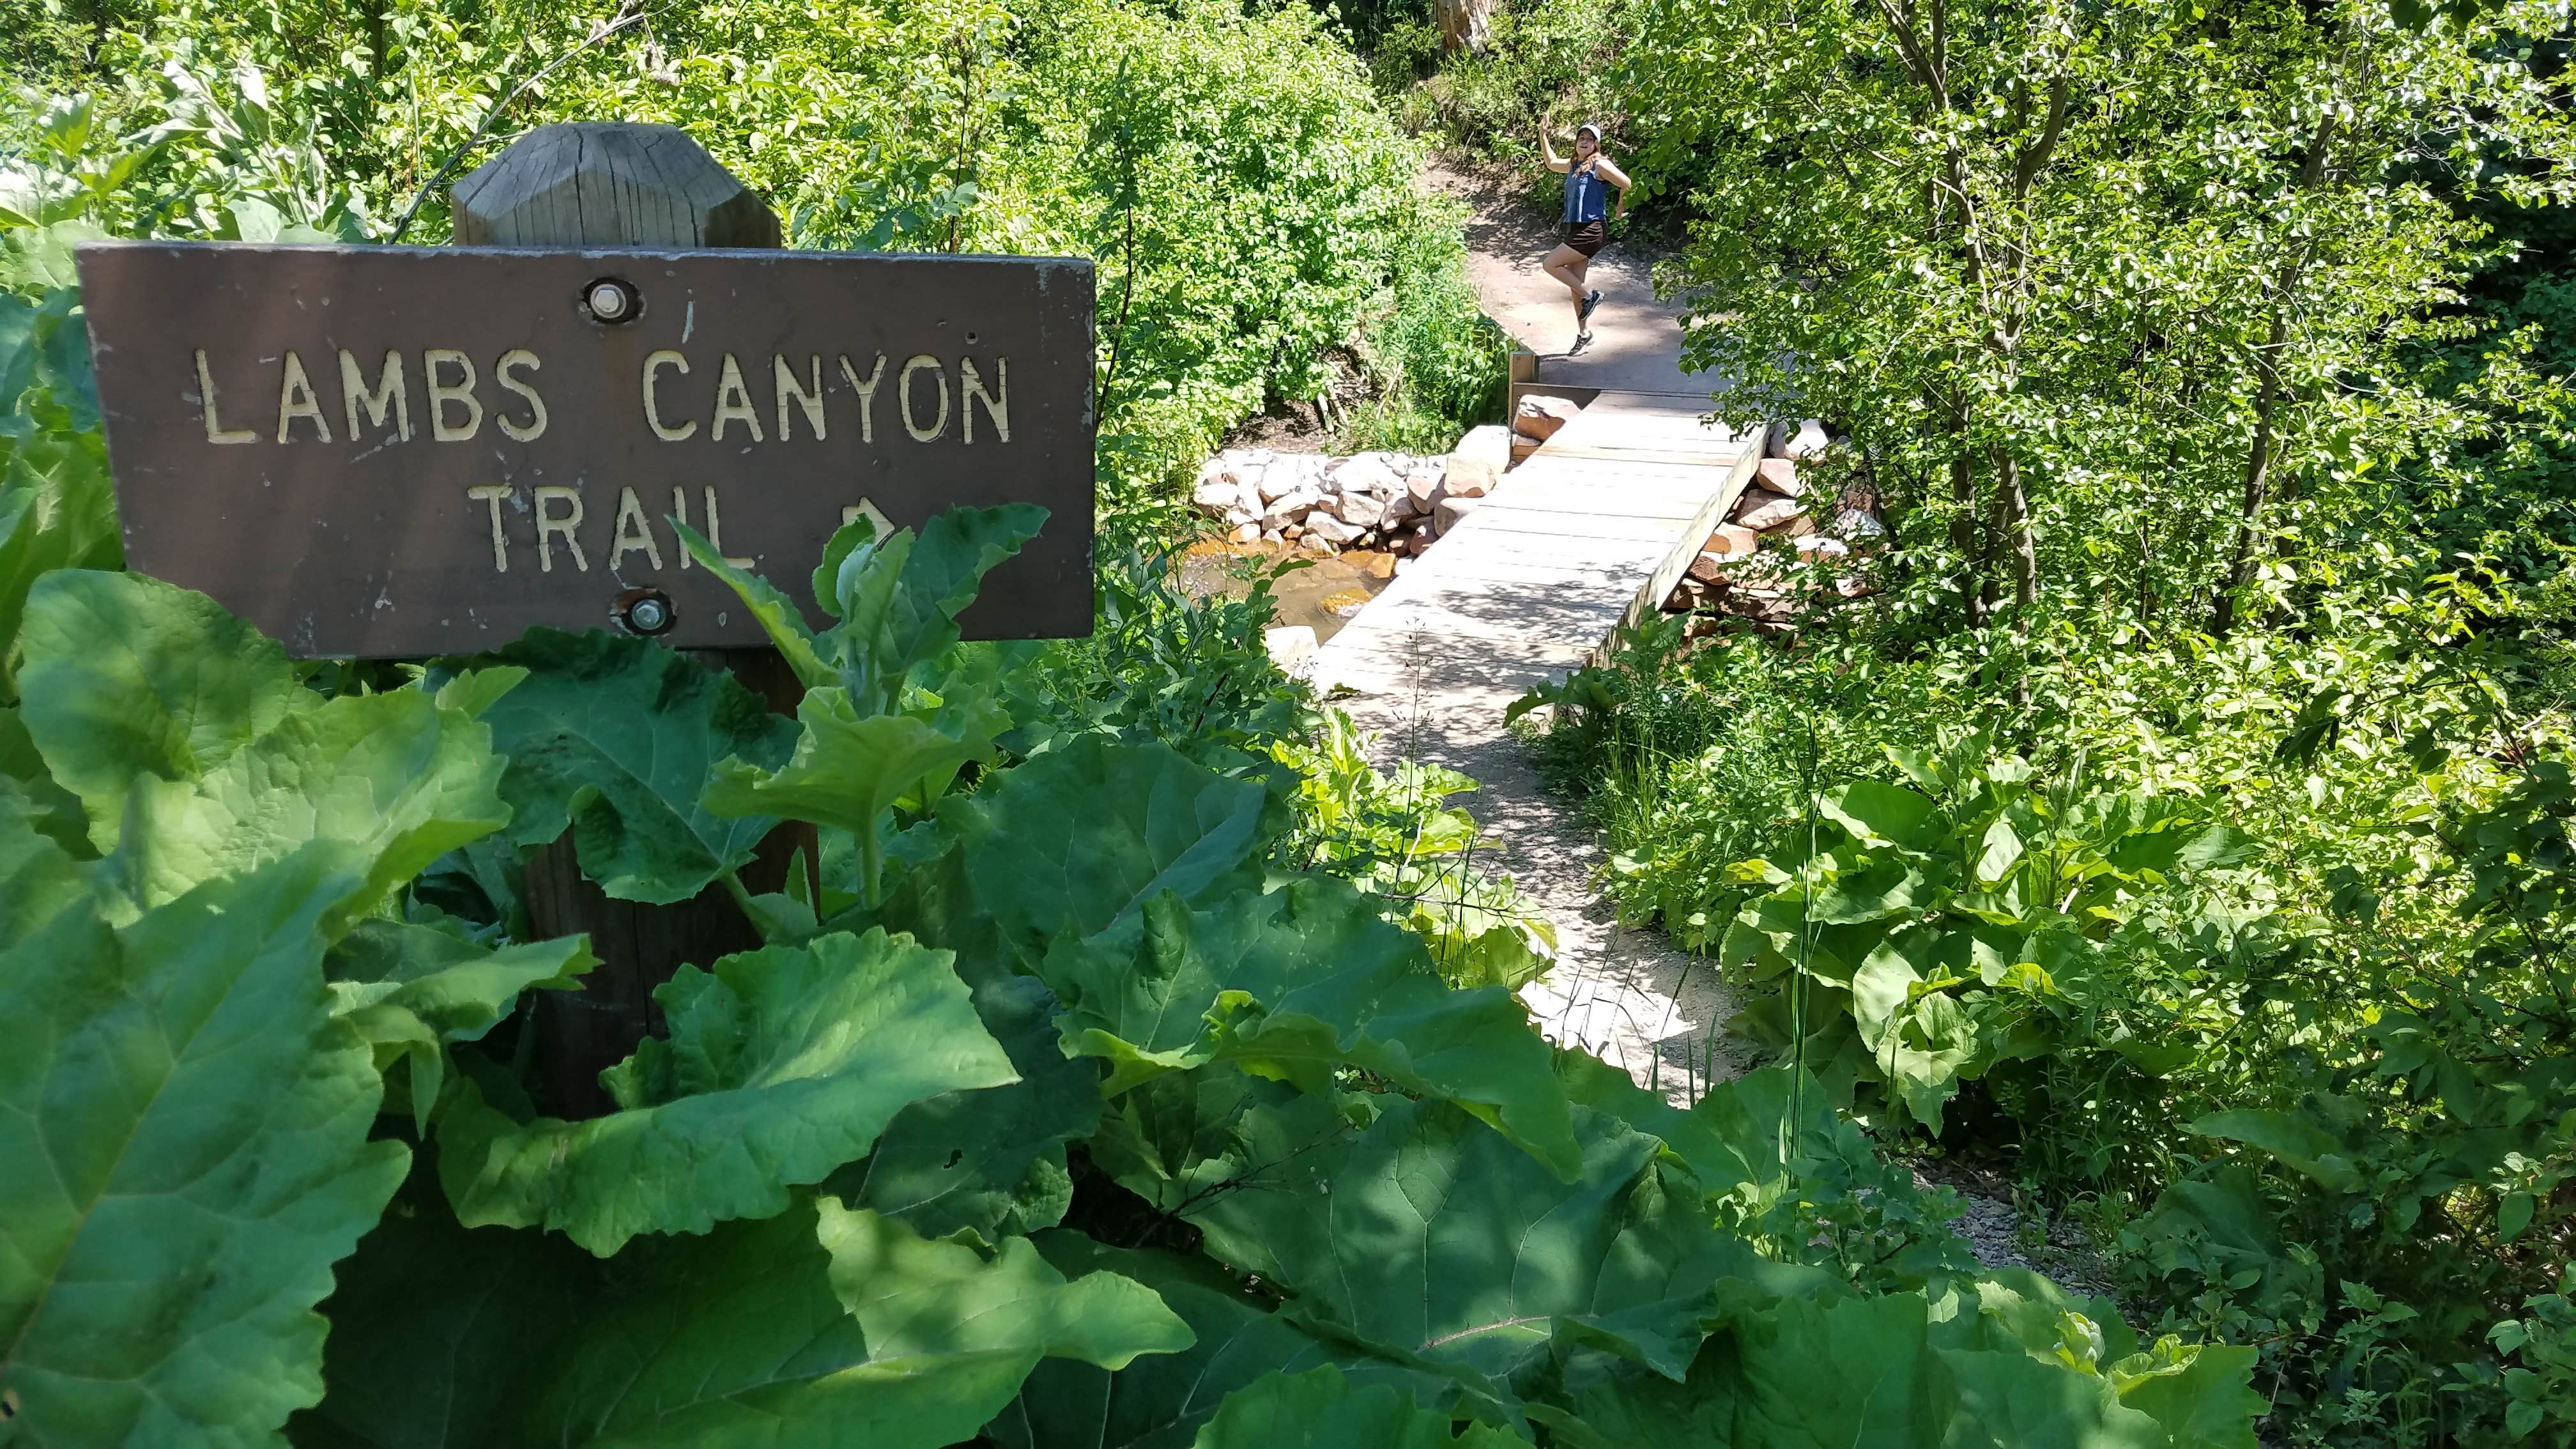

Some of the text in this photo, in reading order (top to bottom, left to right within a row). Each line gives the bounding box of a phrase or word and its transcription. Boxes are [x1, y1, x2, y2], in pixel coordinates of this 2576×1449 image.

[195, 349, 1010, 443] LAMBS CANYON
[468, 485, 755, 572] TRAIL
